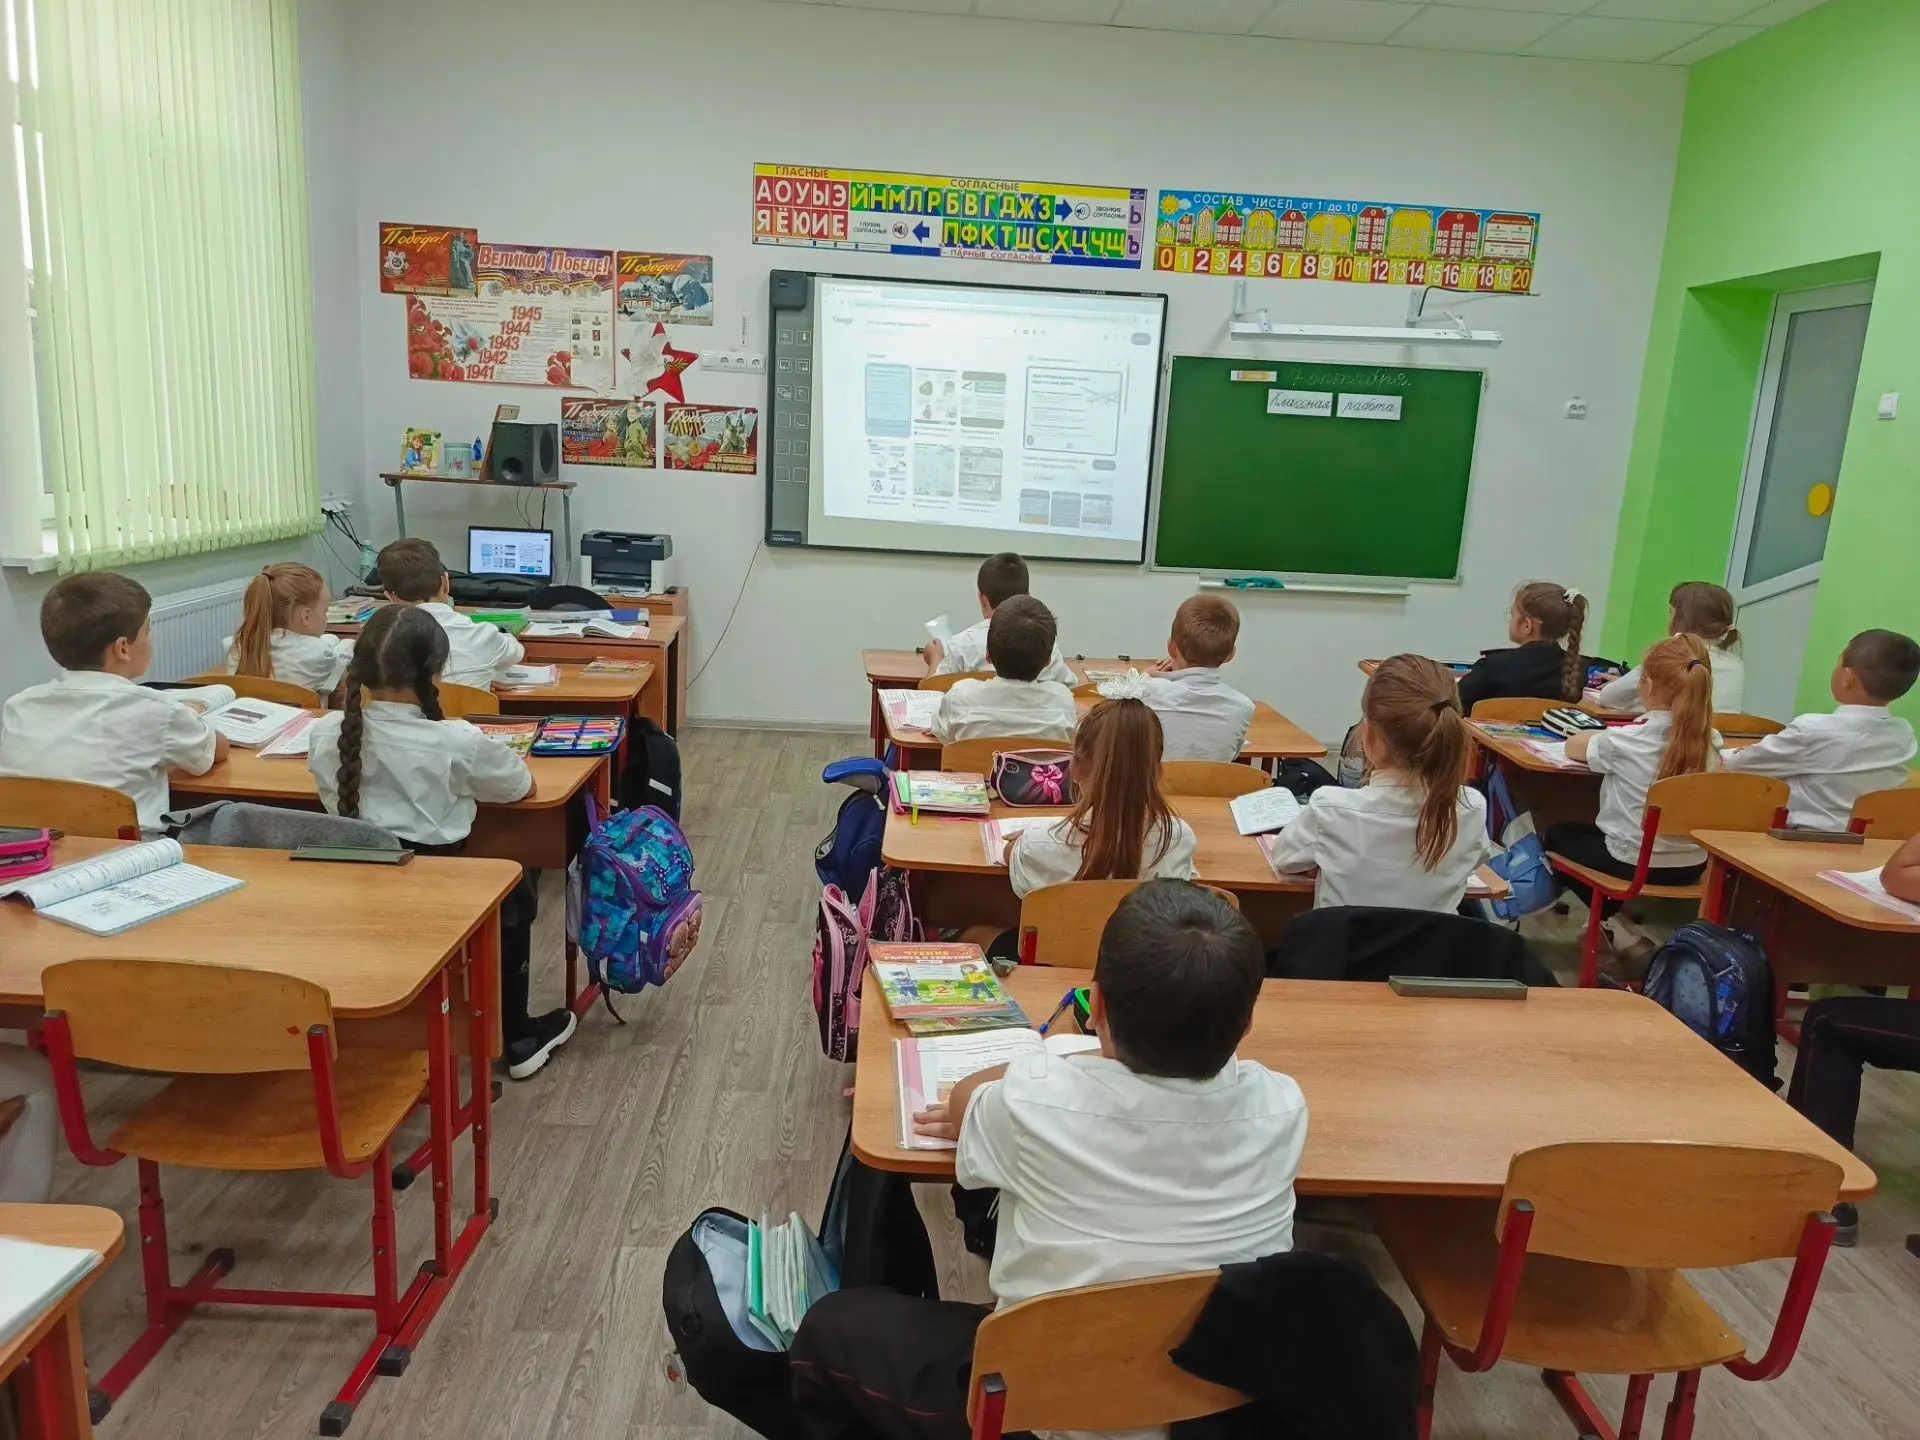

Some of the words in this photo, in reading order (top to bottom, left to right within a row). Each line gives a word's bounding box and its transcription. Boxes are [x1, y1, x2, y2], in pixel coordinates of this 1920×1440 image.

[775, 166, 829, 178] ГЛАСНЫЕ
[950, 179, 1020, 191] СОГЛАСНЫЕ
[1193, 194, 1244, 206] СОСТАВ
[1251, 198, 1293, 209] ЧИСЕЛ
[1301, 201, 1313, 210] от
[1327, 203, 1342, 213] до
[1345, 203, 1358, 213] 10
[1092, 212, 1126, 220] СОГЛАСНЫЕ
[853, 227, 888, 235] СОГЛАСНЫЕ
[382, 227, 450, 253] Победа!
[950, 249, 985, 258] ПАРНЫЕ
[990, 251, 1043, 262] СОГЛАСНЫЕ
[618, 255, 686, 279] Победа!
[1160, 248, 1173, 268] 0
[1180, 252, 1189, 270] 1
[1195, 250, 1210, 271] 2
[1214, 251, 1226, 271] 3
[1229, 252, 1244, 272] 4
[1250, 253, 1262, 273] 5
[1267, 254, 1280, 274] 6
[1287, 255, 1299, 275] 7
[1303, 256, 1316, 276] 8
[1321, 257, 1334, 277] 9
[1335, 258, 1353, 279] 10
[1356, 260, 1369, 279] 11
[1372, 260, 1389, 281] 12
[1391, 261, 1406, 281] 13
[1408, 262, 1424, 282] 14
[1427, 263, 1442, 284] 15
[1443, 264, 1459, 287] 16
[1461, 266, 1477, 287] 17
[1478, 266, 1494, 289] 18
[1497, 267, 1512, 288] 19
[1512, 268, 1529, 290] 20
[511, 305, 543, 321] 1945
[499, 320, 531, 335] 1944
[488, 335, 520, 350] 1943
[477, 350, 508, 364] 1942
[466, 364, 495, 379] 1941
[1269, 392, 1330, 409] Классная
[1343, 398, 1395, 415] работа
[563, 401, 626, 424] Победа!
[665, 406, 732, 430] Победа!
[936, 985, 949, 994] 2
